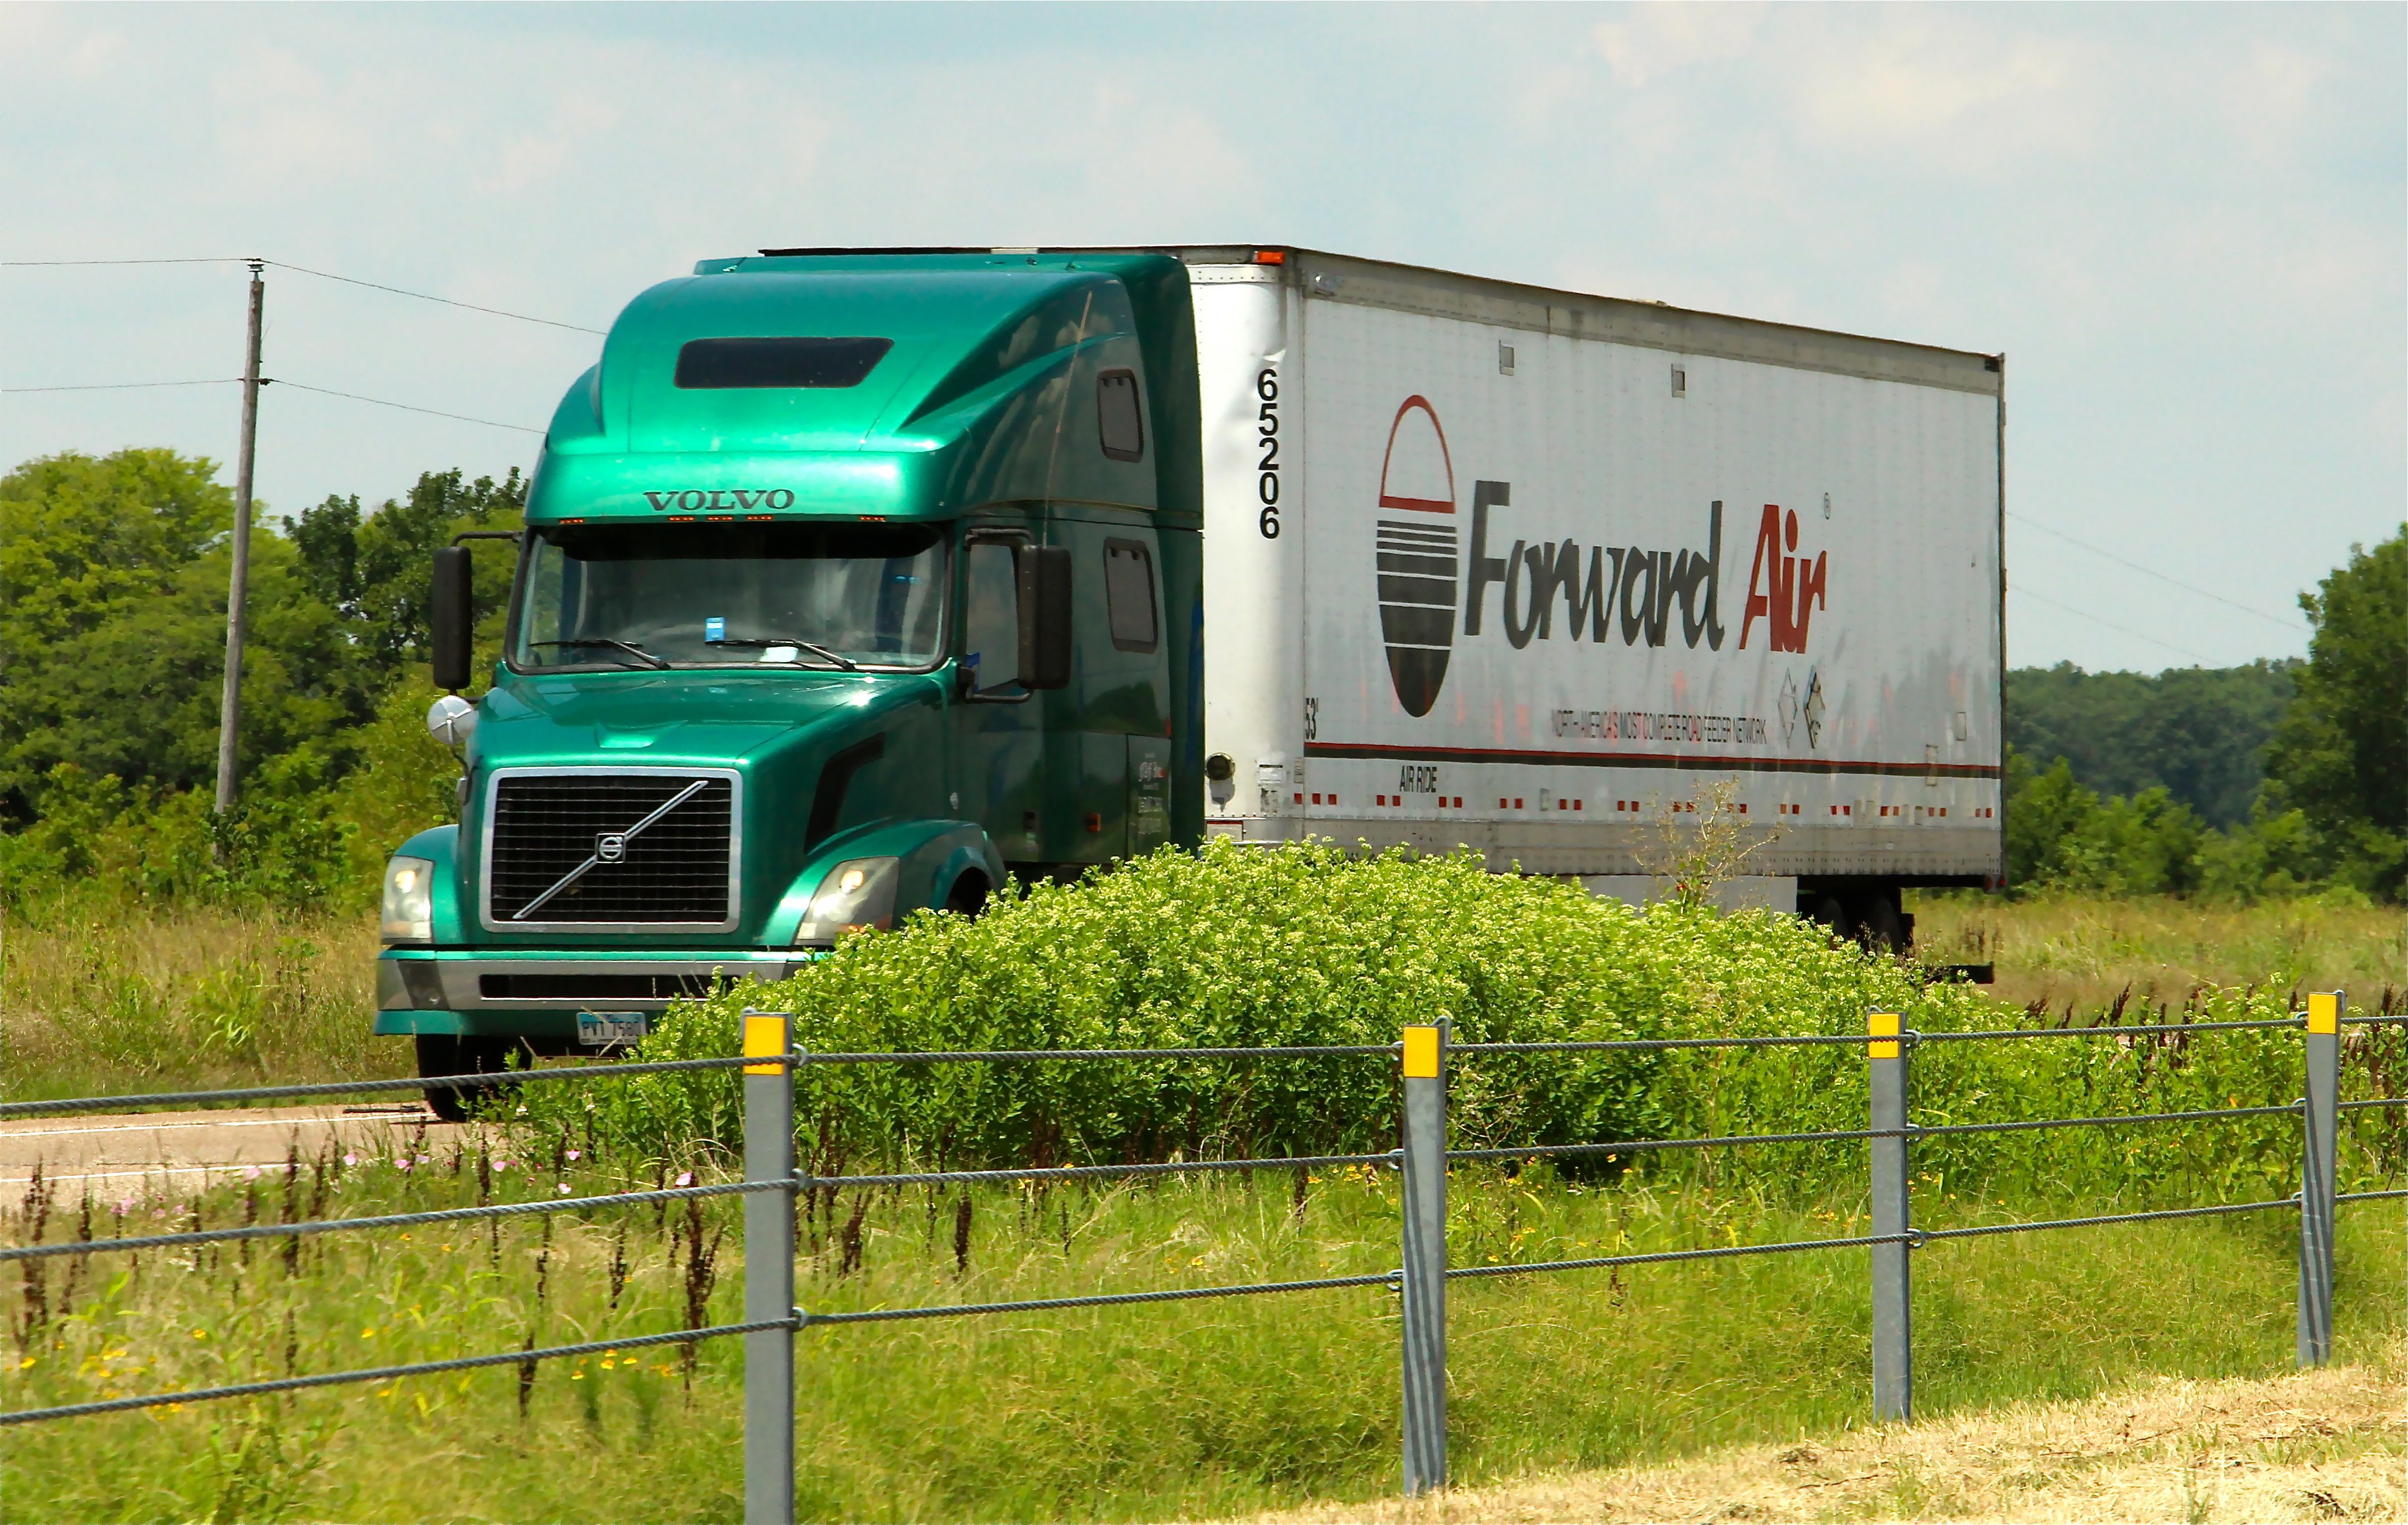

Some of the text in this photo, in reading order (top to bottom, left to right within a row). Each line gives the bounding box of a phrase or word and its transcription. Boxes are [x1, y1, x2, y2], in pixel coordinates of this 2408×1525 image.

[643, 489, 795, 511] VOLVO
[1257, 368, 1280, 539] 65206
[1464, 480, 1827, 654] Forward Air
[1399, 765, 1438, 793] AIR RIDE
